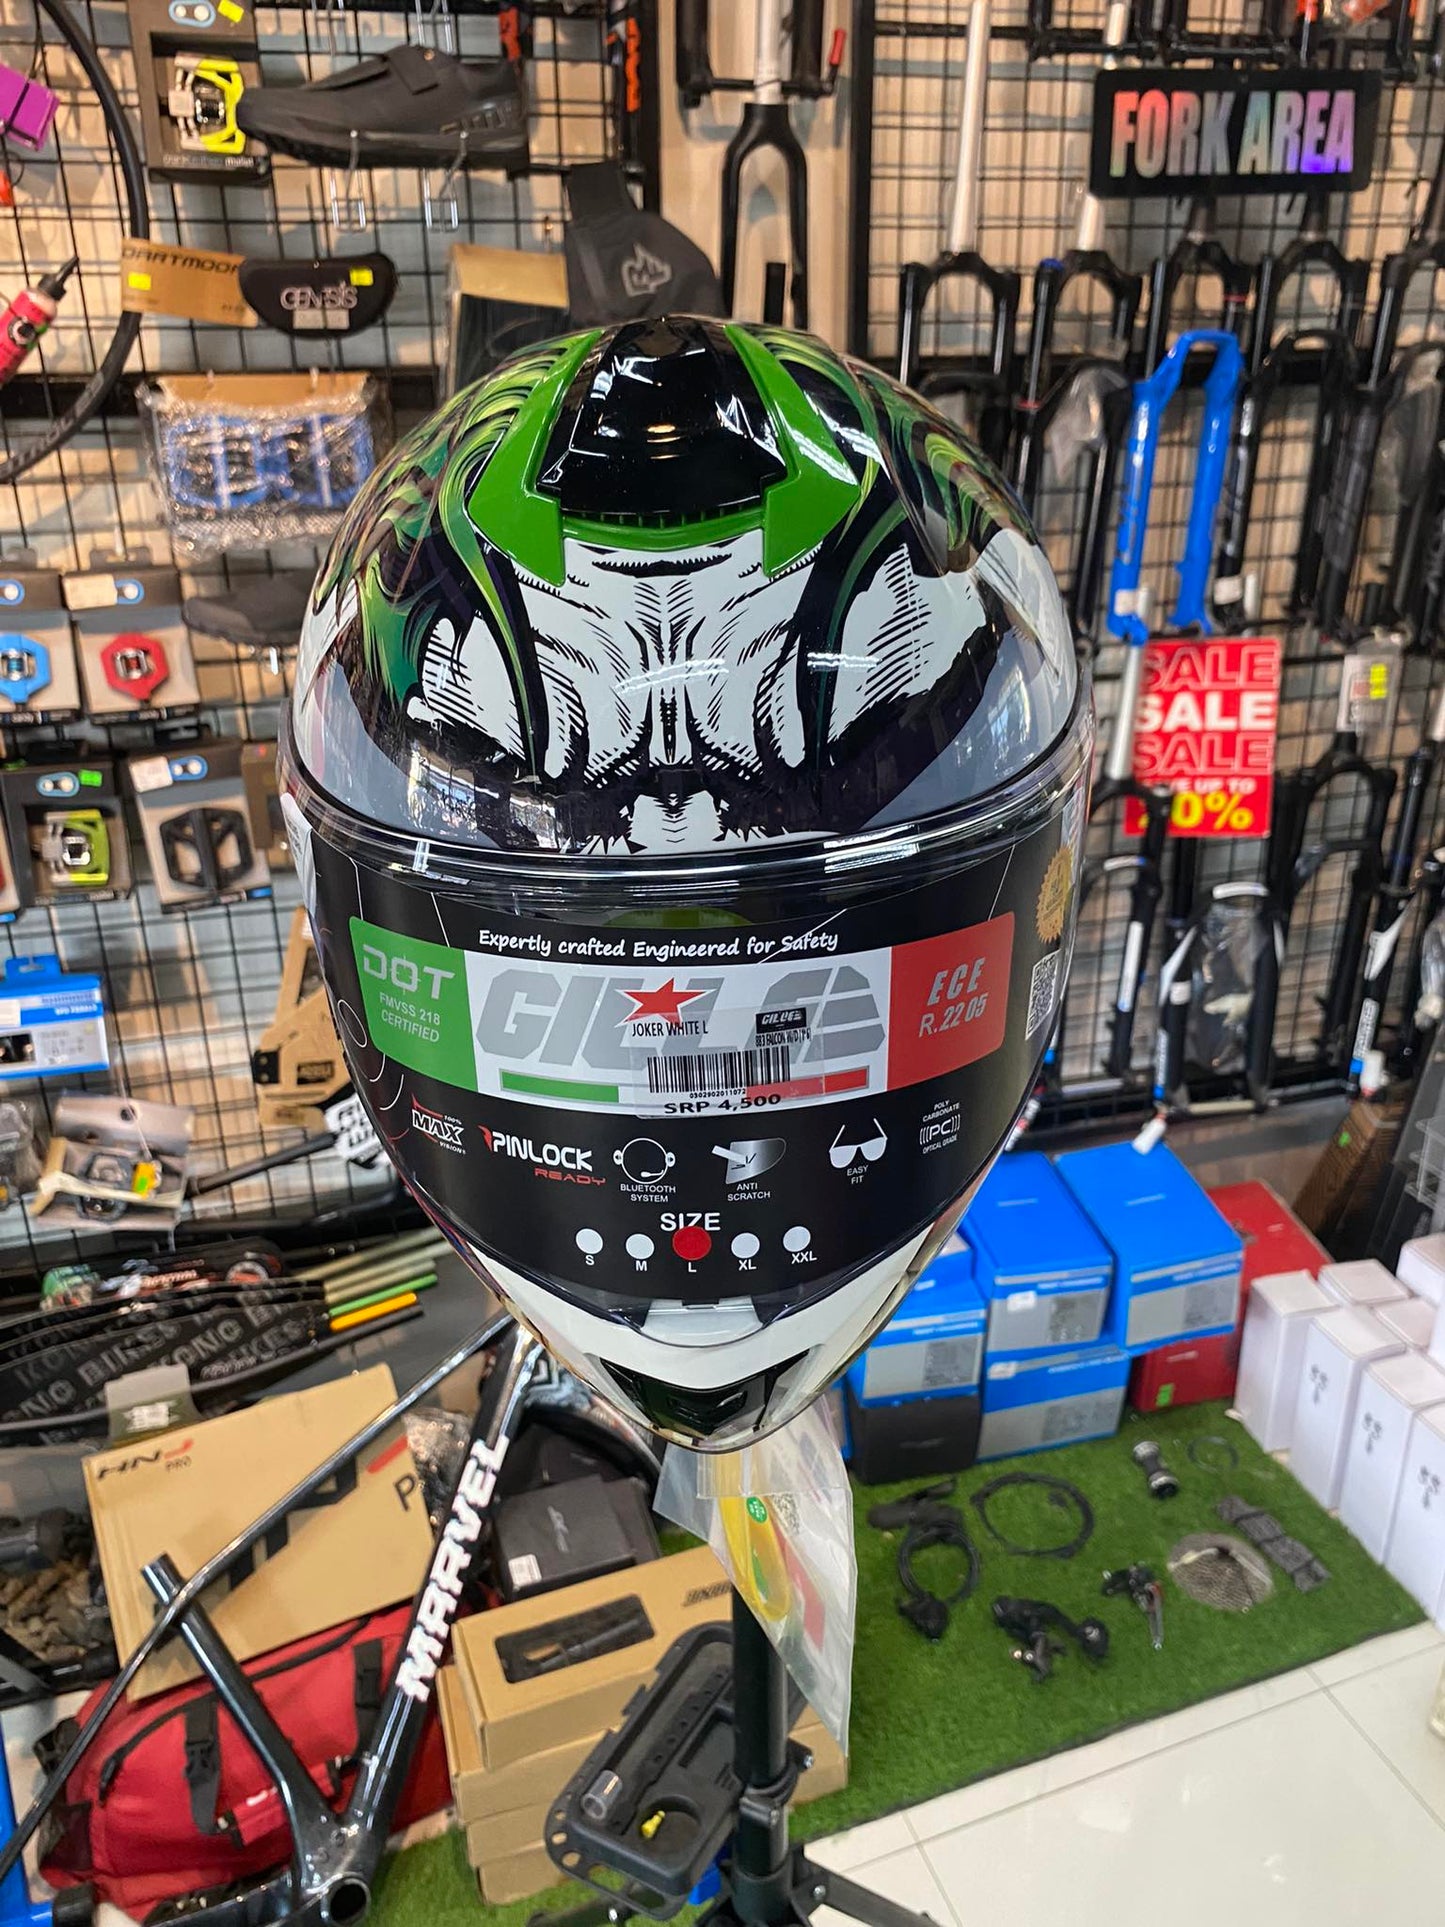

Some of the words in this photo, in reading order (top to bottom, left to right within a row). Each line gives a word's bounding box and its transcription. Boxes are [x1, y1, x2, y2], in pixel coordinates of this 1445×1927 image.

[1110, 91, 1235, 178] FORK
[1236, 91, 1356, 175] AREA
[1144, 644, 1278, 692] SALE
[1135, 691, 1276, 732] SALE
[1133, 732, 1273, 777] SALE
[1193, 778, 1224, 794] UP
[1226, 777, 1256, 795] TO
[479, 929, 551, 957] Expertly
[558, 938, 625, 957] crafted
[633, 937, 739, 963] Engineered
[747, 936, 776, 955] for
[781, 931, 838, 953] Safety
[363, 944, 456, 1000] DOT
[927, 957, 986, 1006] ECE
[380, 991, 416, 1017] FMVSS
[419, 1006, 441, 1025] 218
[381, 1009, 441, 1042] CERTIFIED
[632, 1022, 664, 1037] JOKER
[666, 1021, 699, 1036] WHITE
[700, 1020, 709, 1034] L
[664, 1101, 710, 1114] SRP
[717, 1093, 781, 1111] 4,500
[922, 1102, 960, 1123] CARBONATE
[411, 1108, 464, 1146] MAX
[492, 1131, 593, 1172] PINLOCK
[535, 1167, 606, 1186] READY
[847, 1164, 869, 1176] EASY
[851, 1175, 864, 1185] FIT
[620, 1183, 676, 1194] BLUETOOTH
[630, 1193, 668, 1203] SYSTEM
[727, 1190, 771, 1202] SCRATCH
[736, 1182, 758, 1192] ANTI
[660, 1212, 721, 1232] SIZE
[585, 1255, 595, 1266] S
[635, 1260, 648, 1272] M
[688, 1262, 697, 1273] L
[738, 1259, 757, 1271] XL
[791, 1251, 817, 1264] XXL
[395, 1433, 510, 1703] MARVEL
